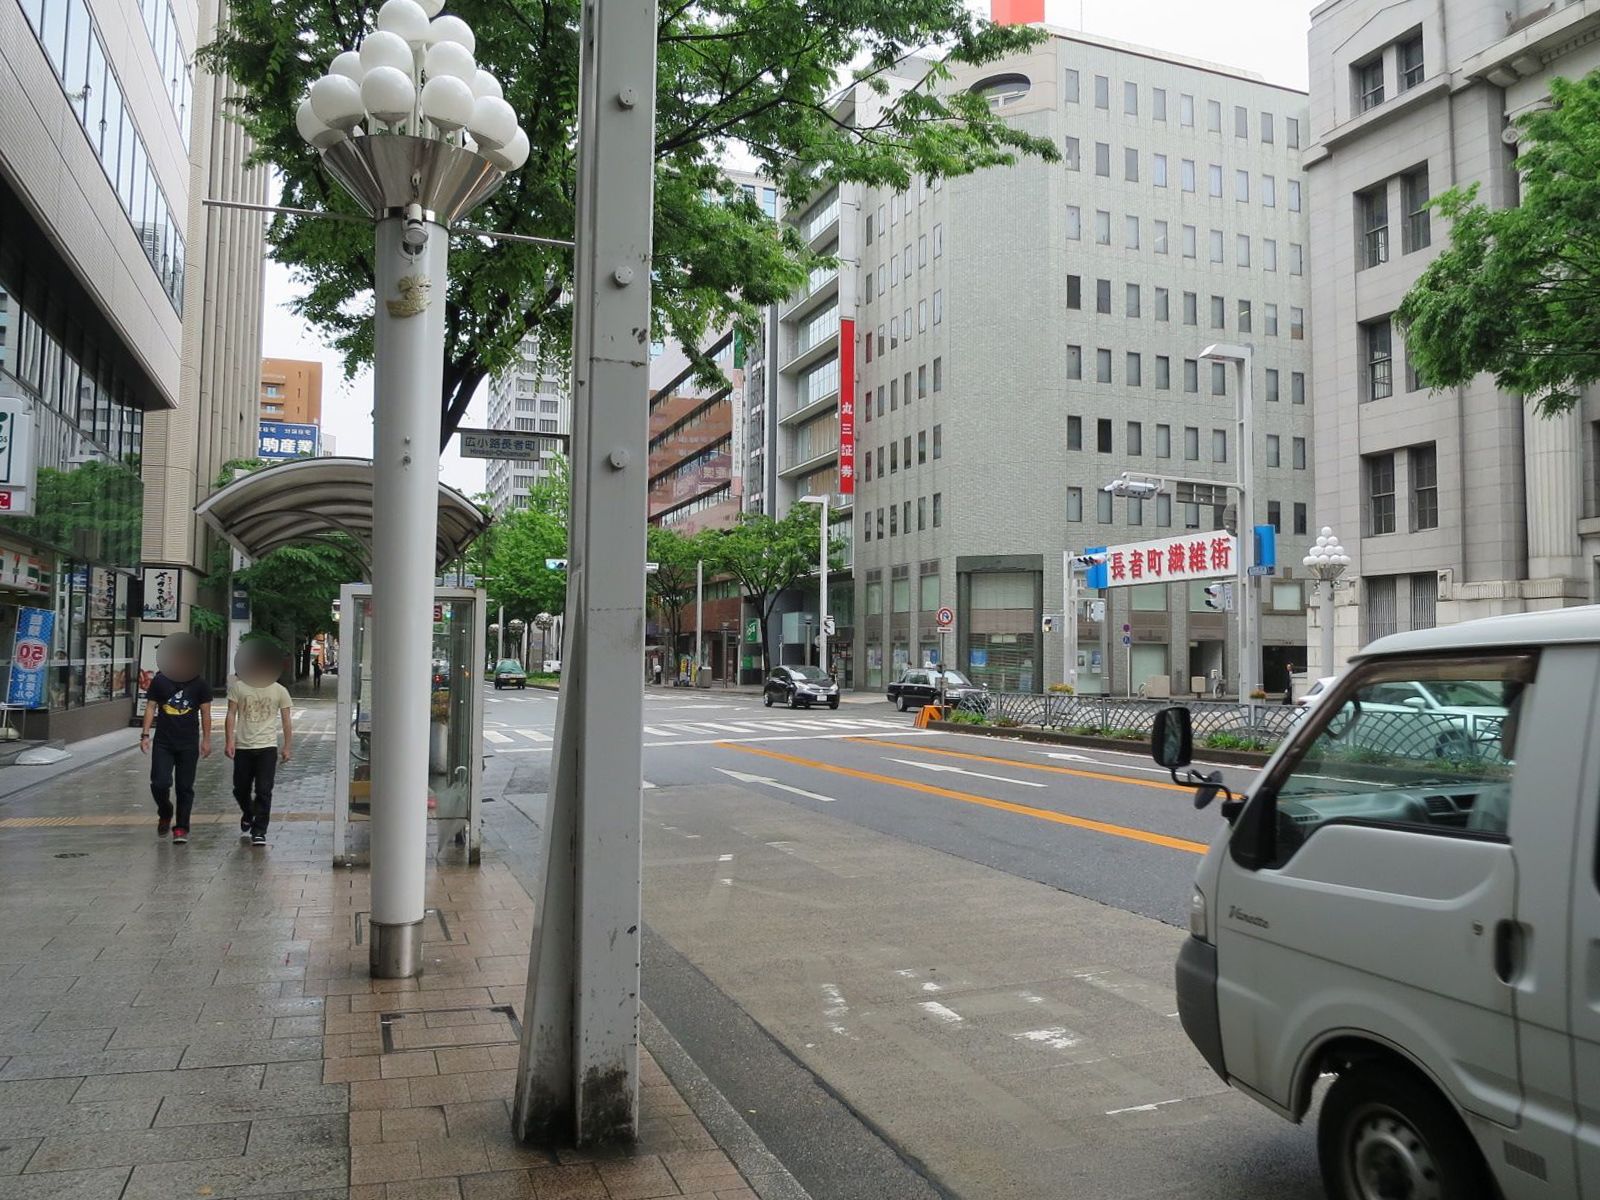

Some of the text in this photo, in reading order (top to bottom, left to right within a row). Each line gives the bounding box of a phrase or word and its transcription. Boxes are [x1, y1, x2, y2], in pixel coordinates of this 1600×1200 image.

[465, 436, 536, 451] 広小路長者町
[841, 401, 853, 478] 丸三証券
[1110, 537, 1232, 580] 長者町繊維街
